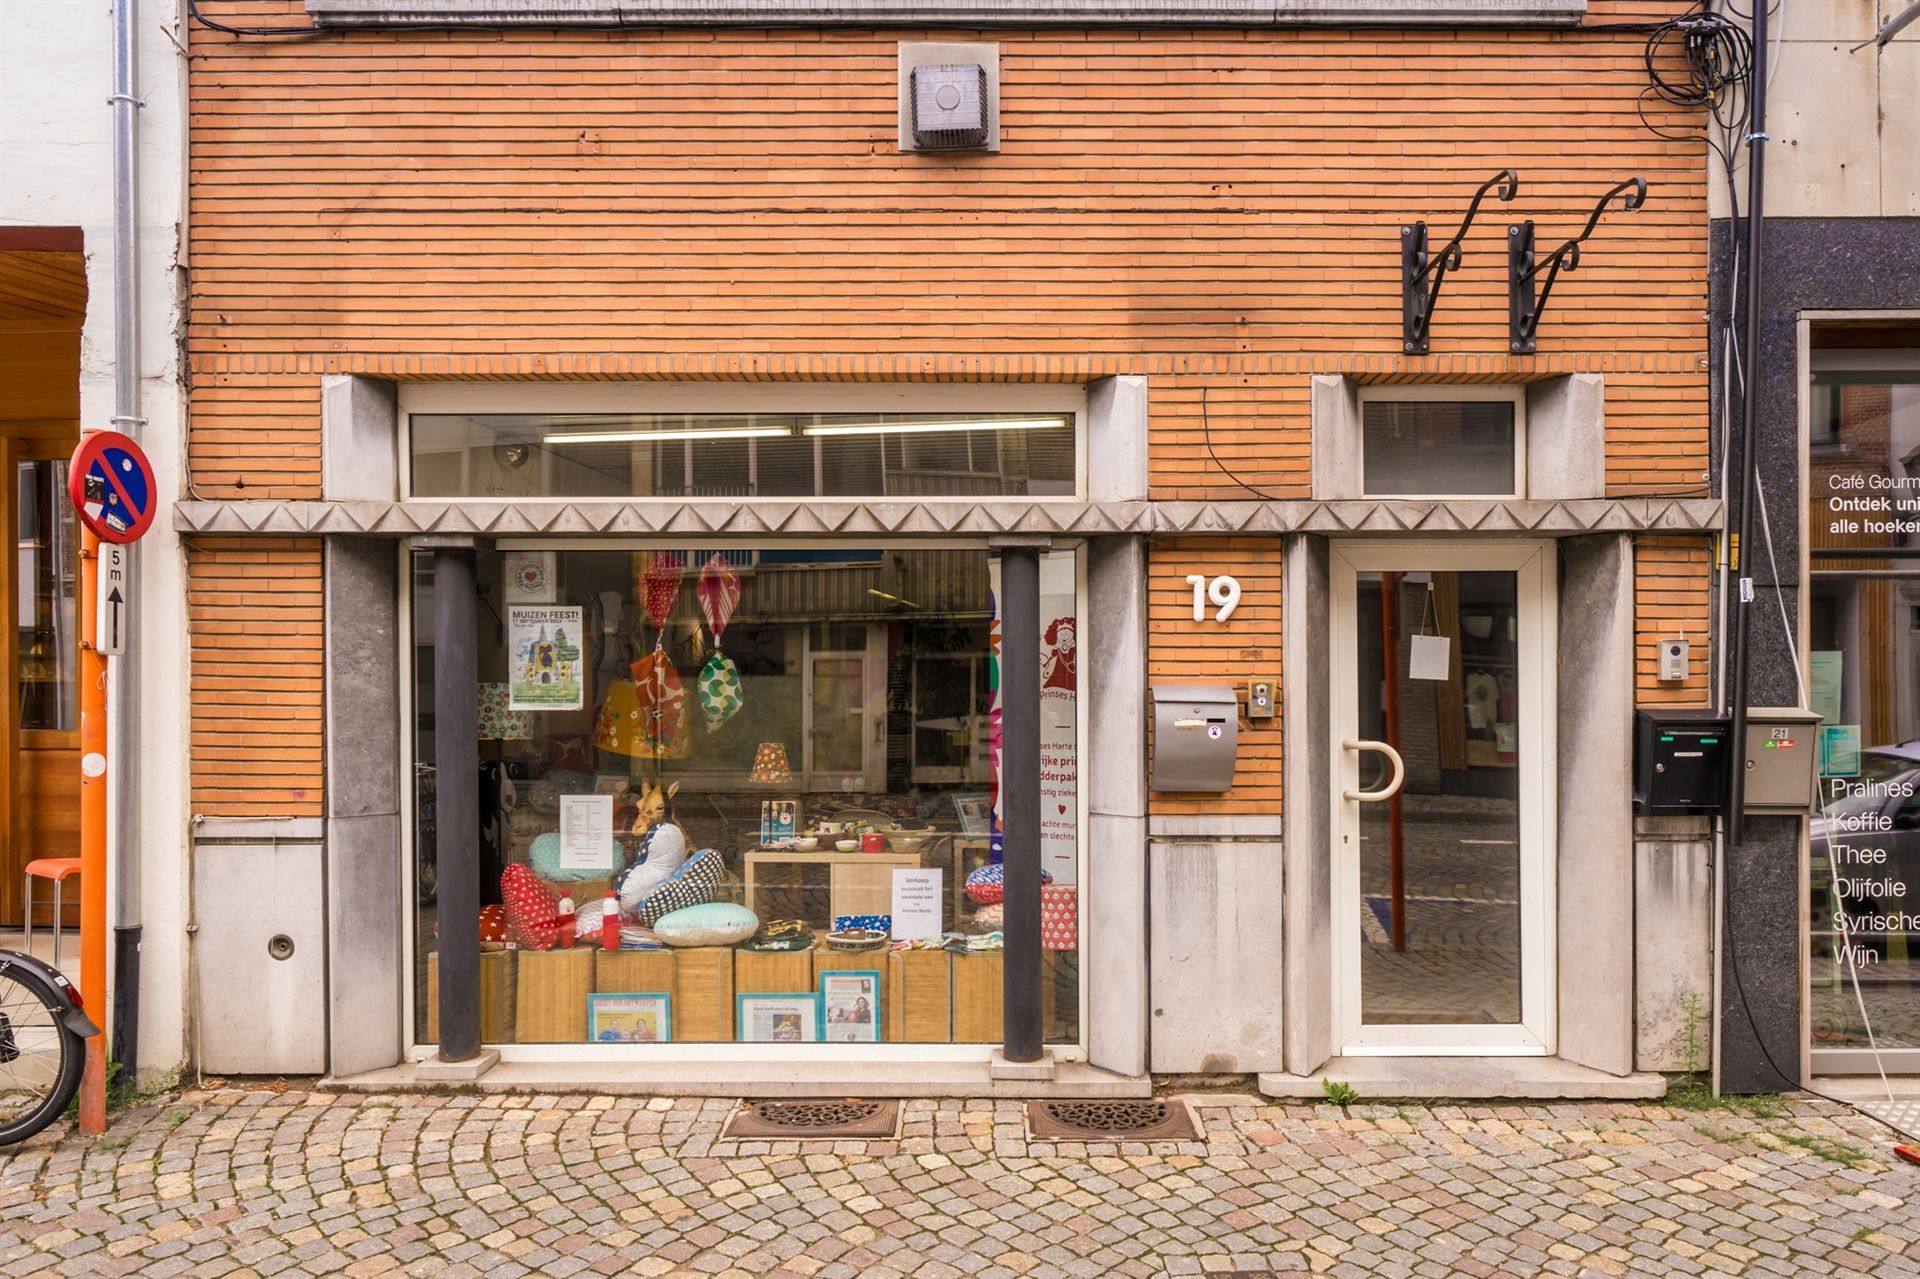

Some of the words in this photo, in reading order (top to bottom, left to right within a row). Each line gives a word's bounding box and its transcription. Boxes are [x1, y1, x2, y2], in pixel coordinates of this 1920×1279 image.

[1829, 474, 1865, 489] Café
[1829, 496, 1891, 511] Ontdek
[1829, 519, 1859, 534] alle
[112, 550, 120, 565] 5
[110, 569, 121, 581] m
[1186, 575, 1242, 623] 19
[512, 611, 547, 619] MUIZEN
[549, 611, 579, 619] FEEST!
[1773, 728, 1786, 739] 21
[1052, 741, 1072, 750] Harte
[1831, 778, 1914, 798] Pralines
[1832, 811, 1893, 831] Koffie
[1050, 831, 1075, 841] slechte
[1831, 844, 1887, 864] Thee
[905, 877, 930, 885] Verkoop
[1833, 877, 1906, 902] Olijfolie
[1833, 911, 1920, 935] Syrische
[1833, 945, 1879, 968] Wijn
